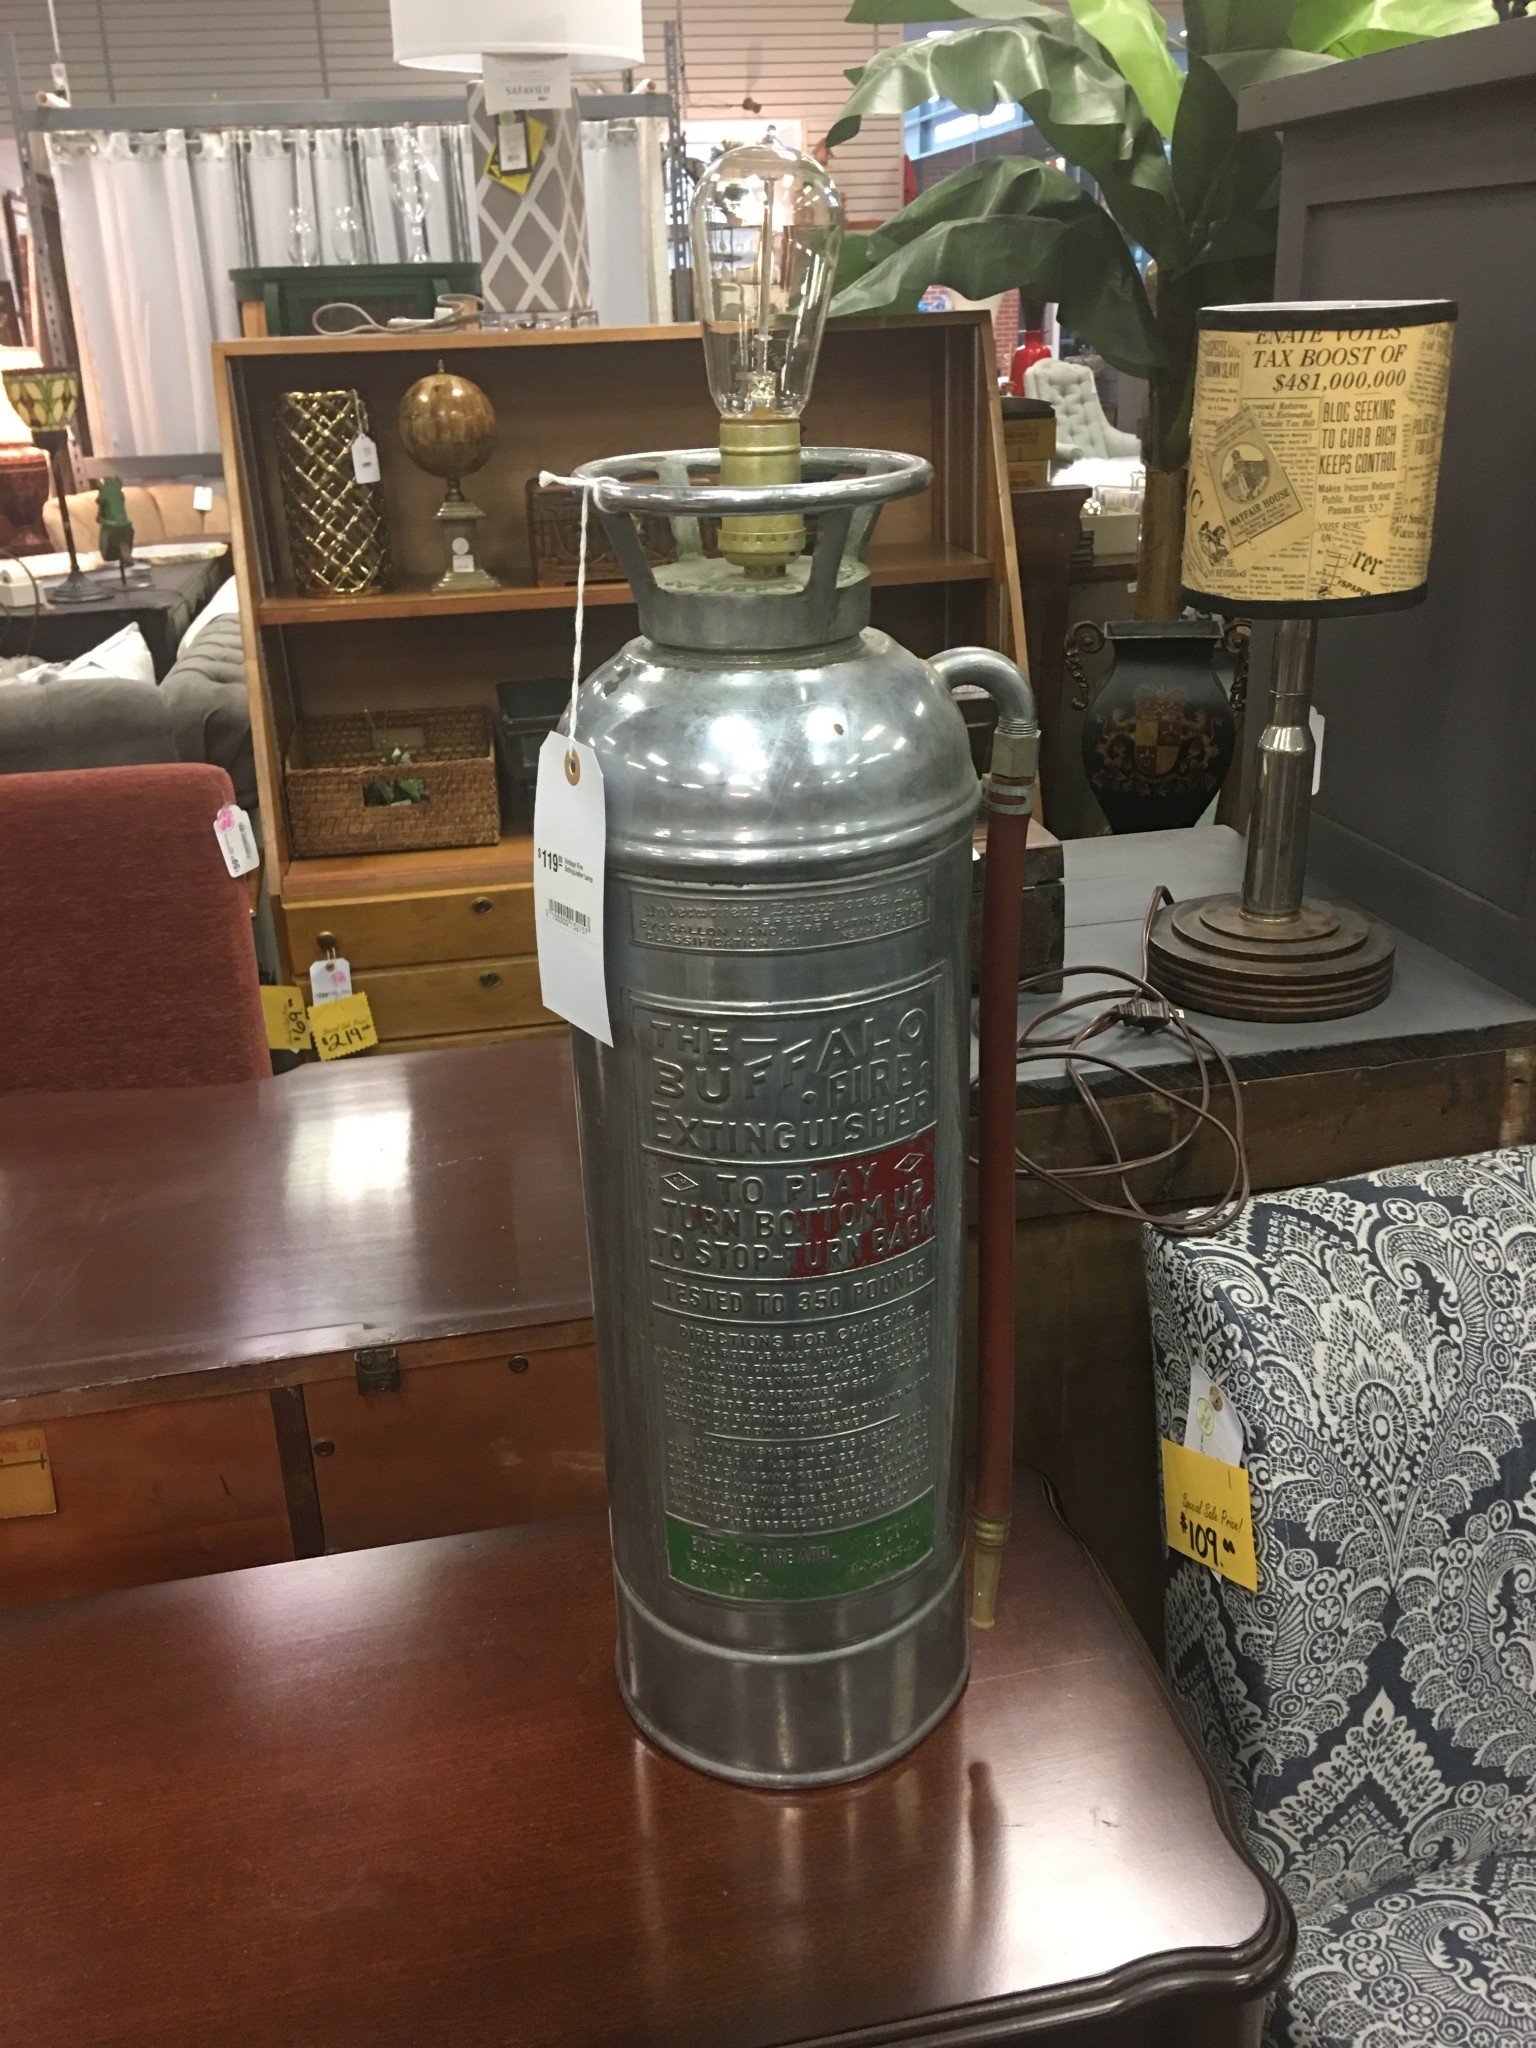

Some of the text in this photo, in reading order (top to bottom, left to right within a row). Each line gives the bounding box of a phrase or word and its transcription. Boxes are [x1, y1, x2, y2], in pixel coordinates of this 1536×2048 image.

[1252, 349, 1294, 368] TAX
[1299, 346, 1376, 367] BOOST
[1380, 344, 1407, 364] OF
[1272, 368, 1407, 394] $481,000,000
[1322, 399, 1396, 422] BLOC SEEKING
[1322, 428, 1336, 449] TO
[1340, 426, 1371, 448] CURB
[1375, 425, 1397, 447] RICH
[1319, 451, 1397, 475] KEEPS CONTROL
[1229, 503, 1263, 527] MAYFAIR
[1263, 487, 1291, 509] HOUSE
[645, 930, 769, 948] CLASSIFICATION
[669, 922, 727, 936] GALLON
[651, 1019, 729, 1055] THE
[652, 1006, 930, 1105] BUFFALO
[651, 1089, 931, 1153] EXTINGUISHER
[716, 1161, 878, 1206] TO PLAY
[661, 1178, 925, 1239] TURN BOTTOM UP
[653, 1227, 685, 1262] TO
[872, 1203, 936, 1256] BACK
[663, 1257, 928, 1315] TESTED TO 350 POUNDS
[678, 1322, 783, 1347] DIRECTIONS
[792, 1328, 828, 1346] FOR
[836, 1300, 915, 1340] CHARGING
[728, 1373, 782, 1386] FASTEN
[1182, 1492, 1244, 1534] Special Sale Price!
